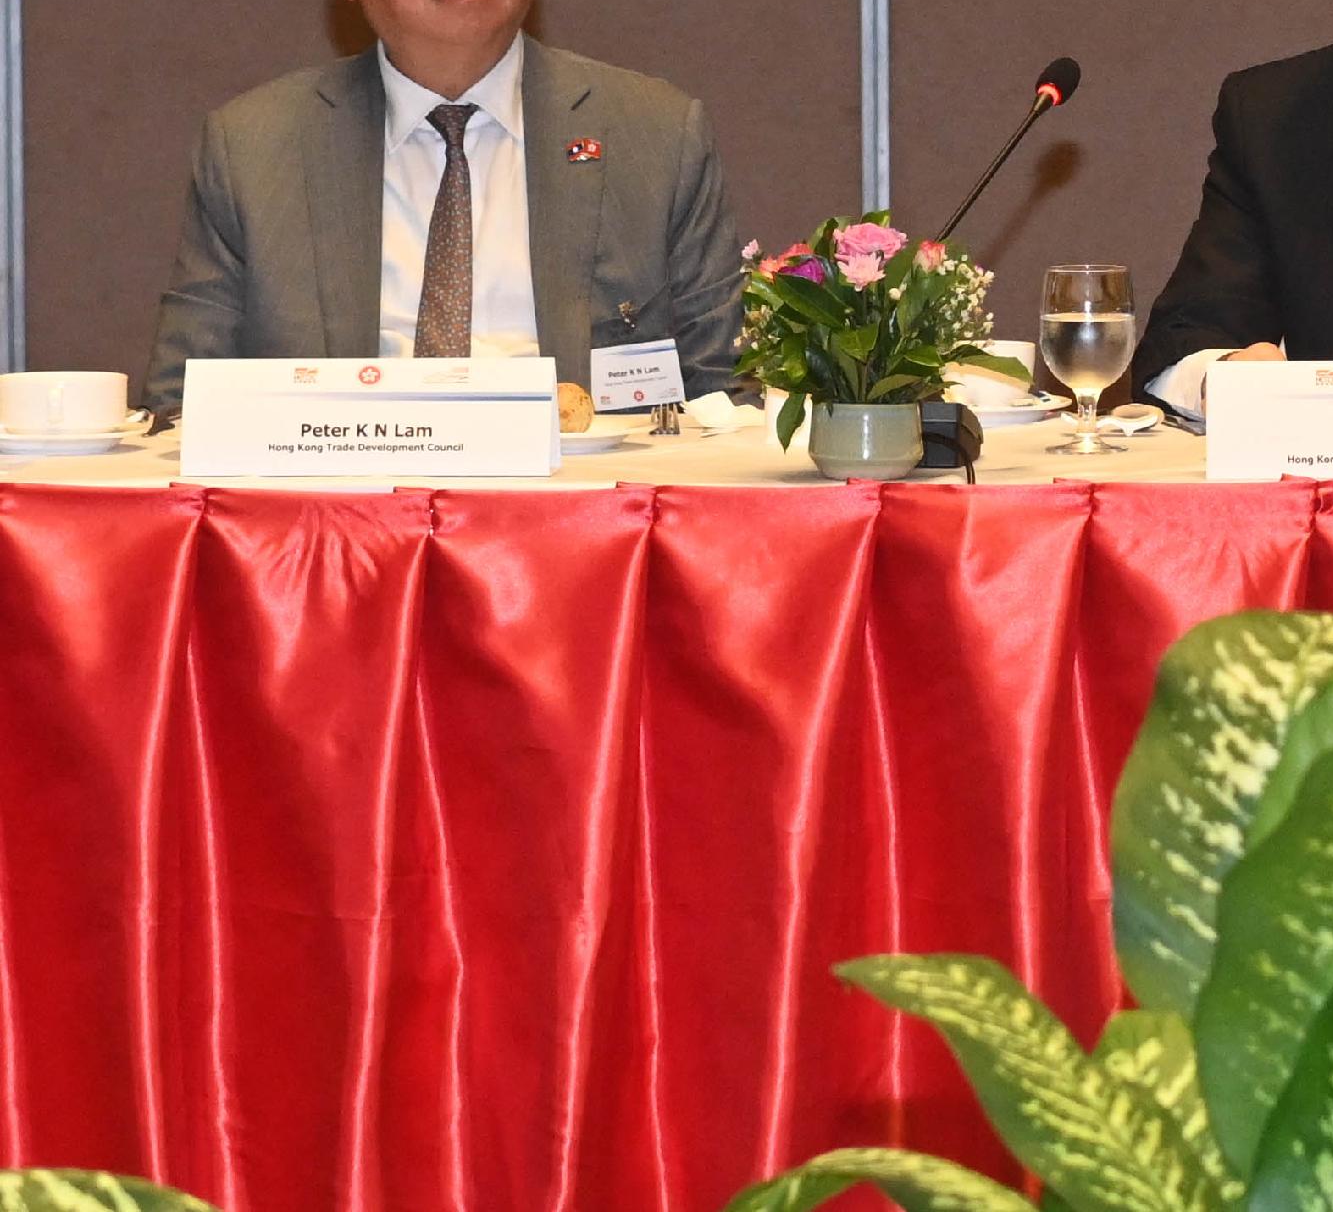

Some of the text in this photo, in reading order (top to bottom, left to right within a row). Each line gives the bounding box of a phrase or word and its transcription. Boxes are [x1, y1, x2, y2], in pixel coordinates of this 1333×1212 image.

[301, 424, 432, 437] Peter K N Lam
[268, 443, 464, 453] Hong Kong Trade Development Council
[1287, 455, 1314, 465] Hong
